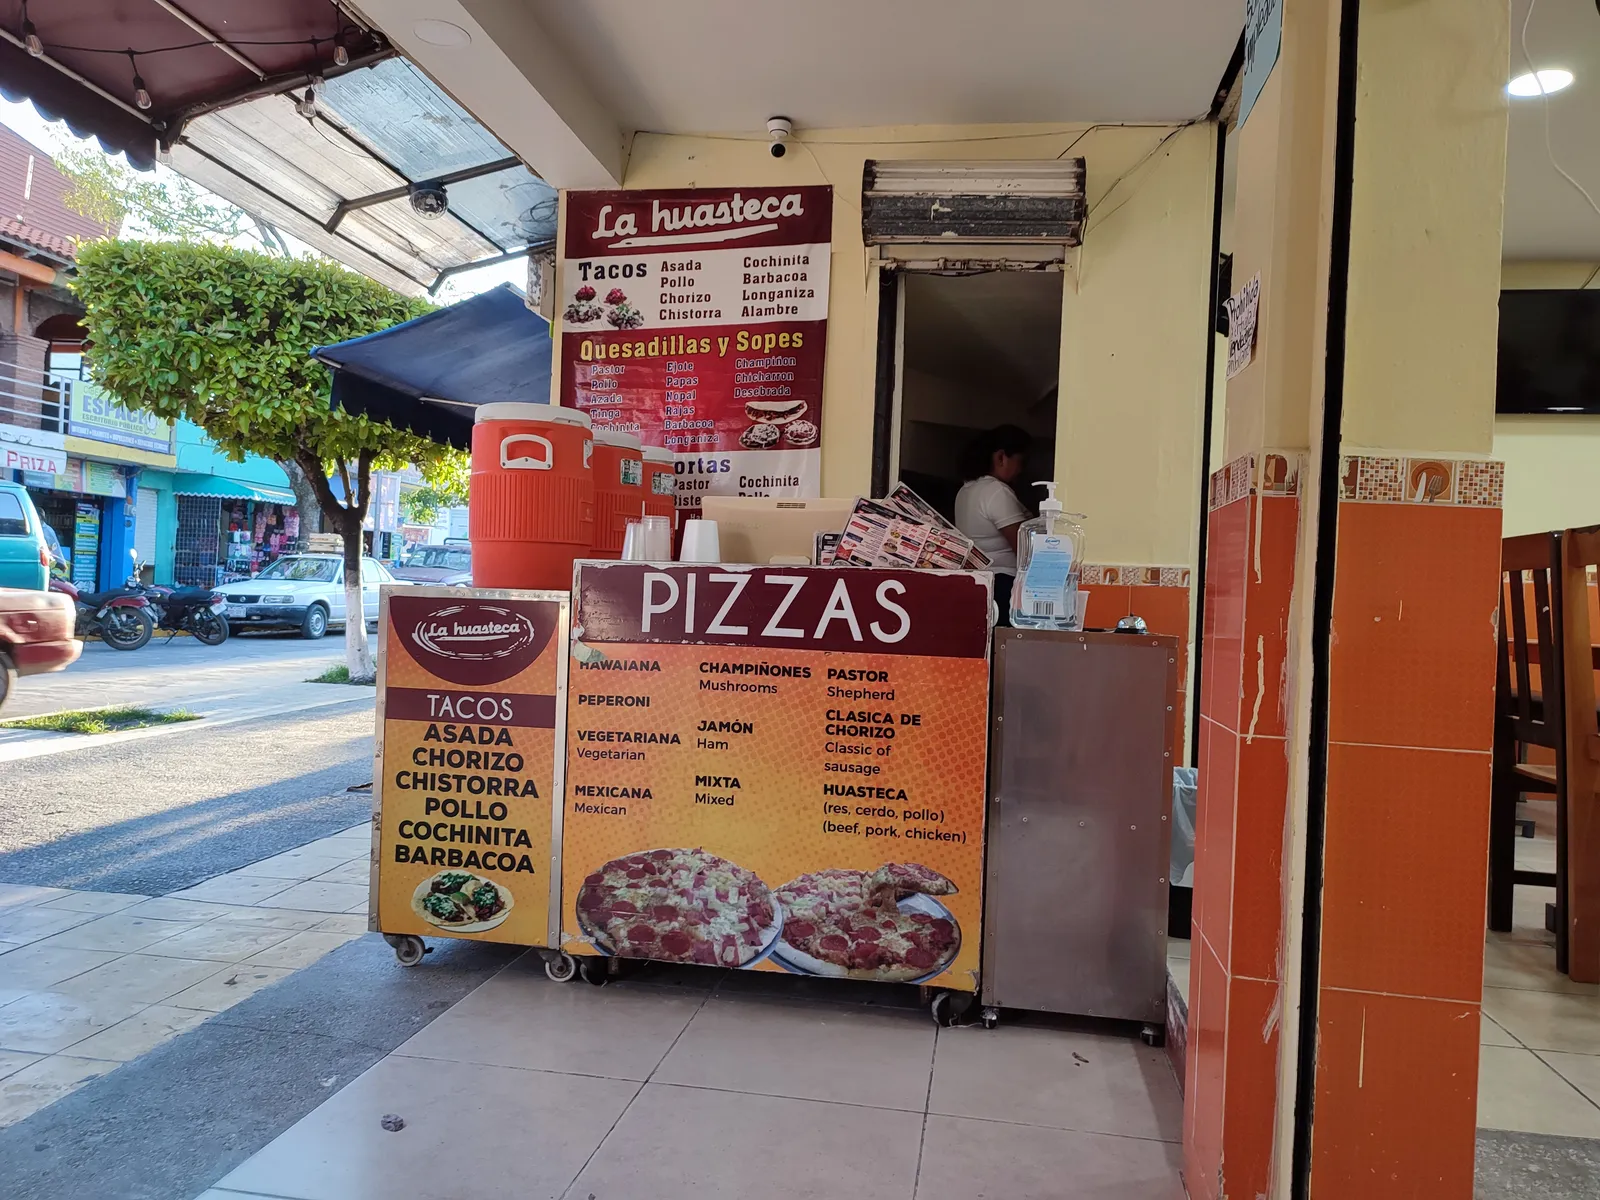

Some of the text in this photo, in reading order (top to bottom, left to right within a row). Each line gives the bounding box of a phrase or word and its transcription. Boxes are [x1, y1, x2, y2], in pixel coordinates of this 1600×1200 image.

[592, 193, 804, 239] La huasteca
[660, 260, 702, 272] Asada
[743, 255, 810, 268] Cochinita
[578, 262, 648, 281] Tacos
[743, 271, 808, 285] Barbacoa
[660, 276, 695, 288] Pollo
[660, 292, 711, 304] Chorizo
[742, 287, 815, 302] Longaniza
[659, 308, 722, 320] Chistorra
[741, 304, 799, 318] Alambre
[580, 331, 804, 361] Quesadillas y Sopes
[591, 364, 626, 375] Pastor
[666, 361, 694, 373] Ejote
[591, 379, 618, 390] Pollo
[666, 376, 698, 388] Papas
[734, 371, 794, 384] Chicharron
[590, 394, 623, 404] Azada
[665, 390, 697, 402] Nopal
[734, 386, 791, 398] Desebrada
[590, 408, 620, 420] Tinga
[665, 405, 695, 416] Rajas
[664, 419, 715, 430] Barbacoa
[664, 433, 720, 446] Longaniza
[7, 450, 57, 473] PRIZA
[674, 458, 731, 475] ortas
[739, 474, 799, 489] Cochinita
[641, 572, 912, 644] PIZZAS
[428, 621, 520, 637] La huasteca
[580, 660, 661, 671] HAWAIANA
[699, 660, 812, 679] CHAMPIÑONES
[827, 668, 889, 683] PASTOR
[699, 680, 778, 695] Mushrooms
[827, 685, 895, 701] Shepherd
[426, 694, 513, 721] TACOS
[578, 694, 651, 707] PEPERONI
[826, 709, 921, 726] CLASICA DE
[697, 718, 754, 735] JAMÓN
[825, 724, 895, 739] CHORIZO
[424, 723, 513, 746] ASADA
[577, 730, 681, 745] VEGETARIANA
[697, 738, 729, 750] Ham
[825, 741, 891, 757] Classic of
[412, 747, 524, 772] CHORIZO
[577, 747, 646, 762] Vegetarian
[824, 761, 881, 776] sausage
[395, 770, 539, 798] CHISTORRA
[695, 775, 741, 789] MIXTA
[574, 785, 653, 800] MEXICANA
[695, 793, 735, 807] Mixed
[823, 784, 908, 801] HUASTECA
[425, 797, 508, 821] POLLO
[574, 802, 627, 816] Mexican
[823, 802, 945, 824] (res, cerdo, pollo)
[398, 820, 532, 848] COCHINITA
[822, 821, 967, 844] (beef, pork, chicken)
[395, 844, 534, 873] BARBACOA
